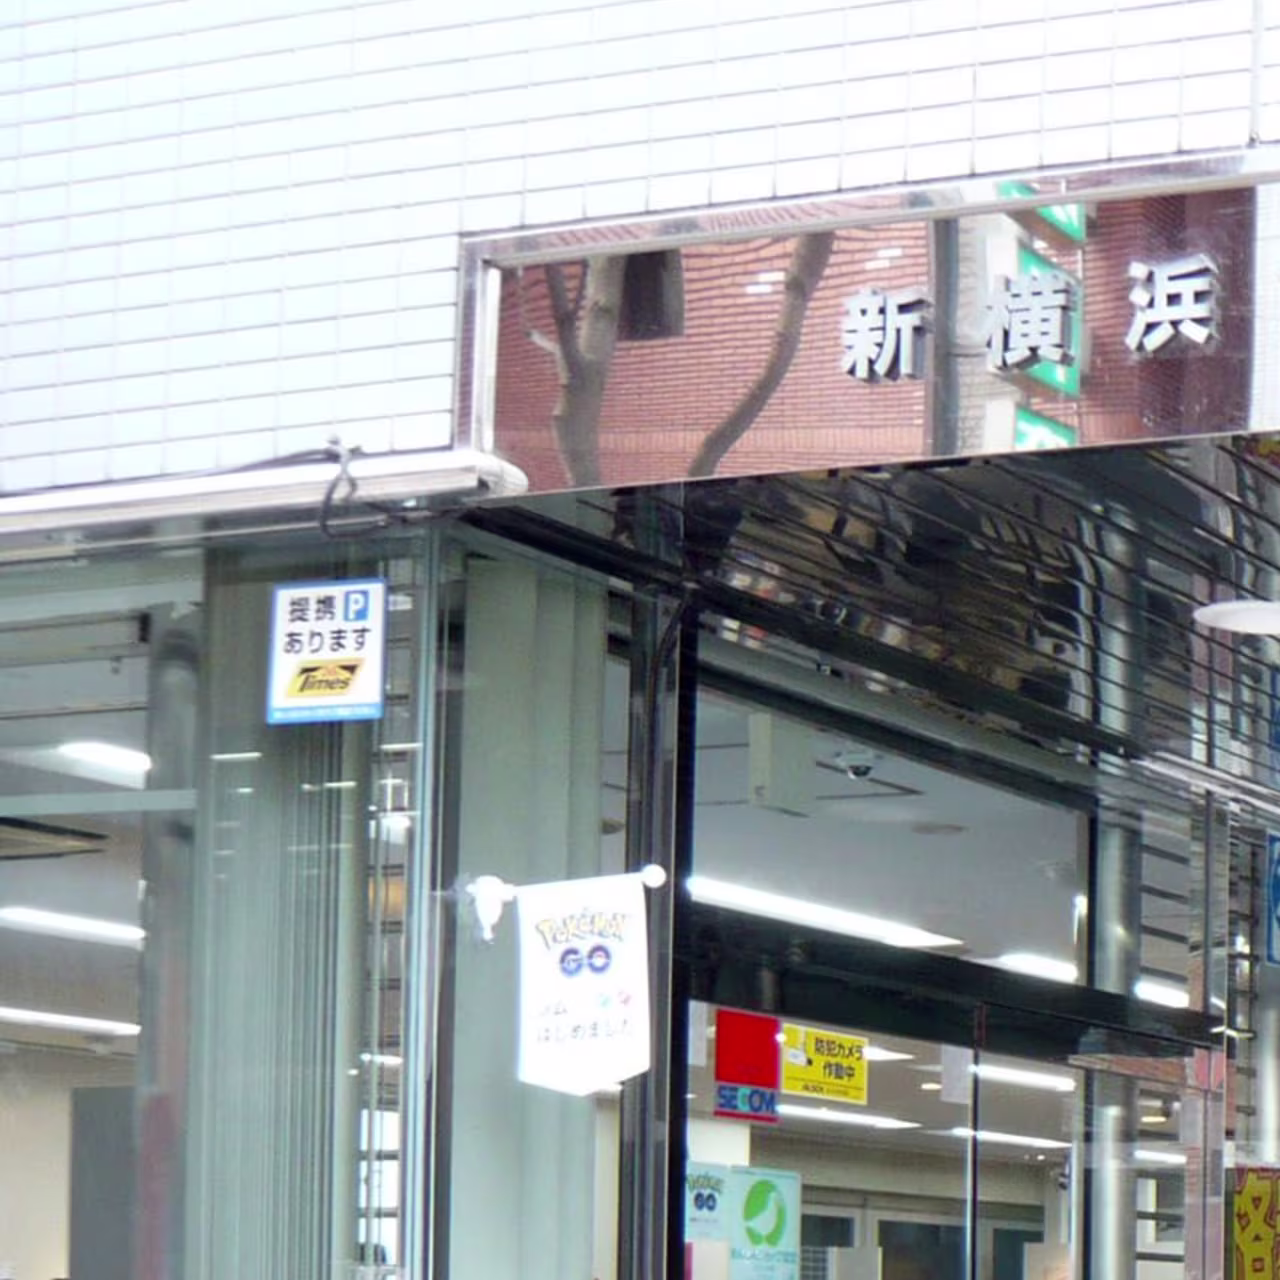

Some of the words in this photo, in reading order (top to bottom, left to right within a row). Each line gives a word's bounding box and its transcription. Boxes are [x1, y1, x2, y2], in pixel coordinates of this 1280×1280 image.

[283, 627, 371, 654] あります
[298, 665, 357, 693] Times
[560, 944, 611, 977] GO
[717, 1085, 777, 1113] SECOM
